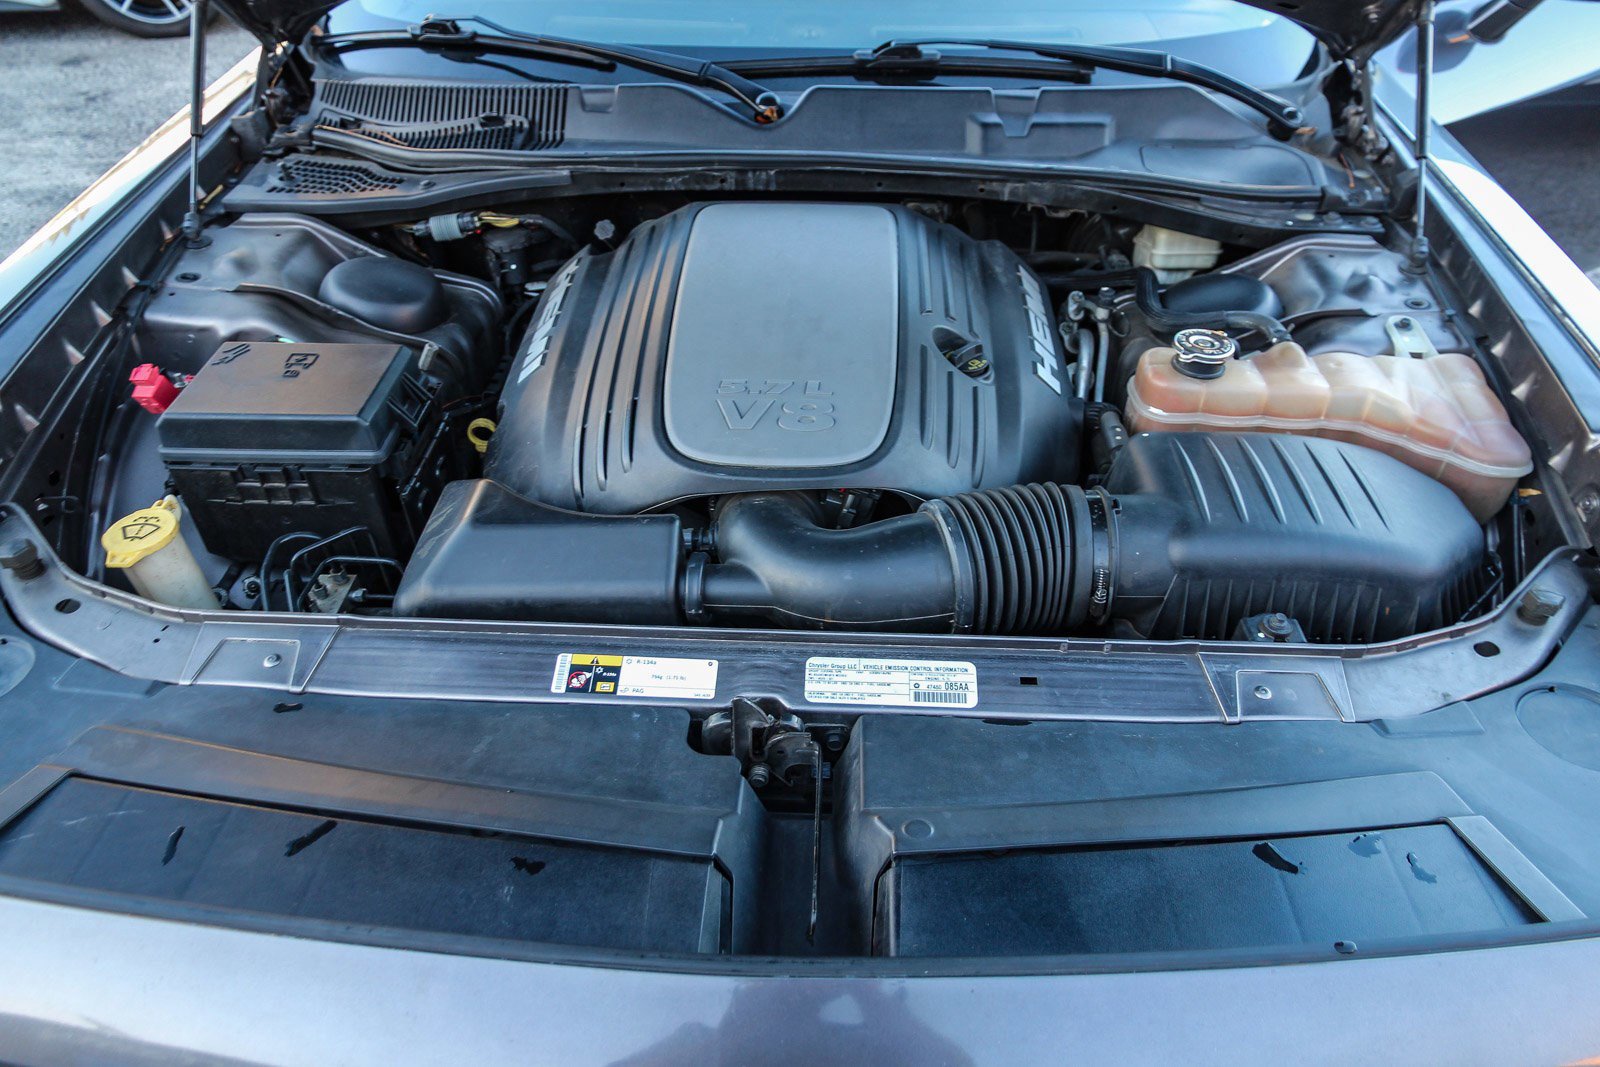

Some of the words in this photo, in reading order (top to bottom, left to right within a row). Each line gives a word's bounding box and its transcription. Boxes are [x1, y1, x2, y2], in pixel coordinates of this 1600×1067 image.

[1017, 264, 1062, 395] HEMI
[716, 379, 834, 395] 5.7L
[715, 399, 836, 432] V8
[944, 682, 969, 691] 085AA
